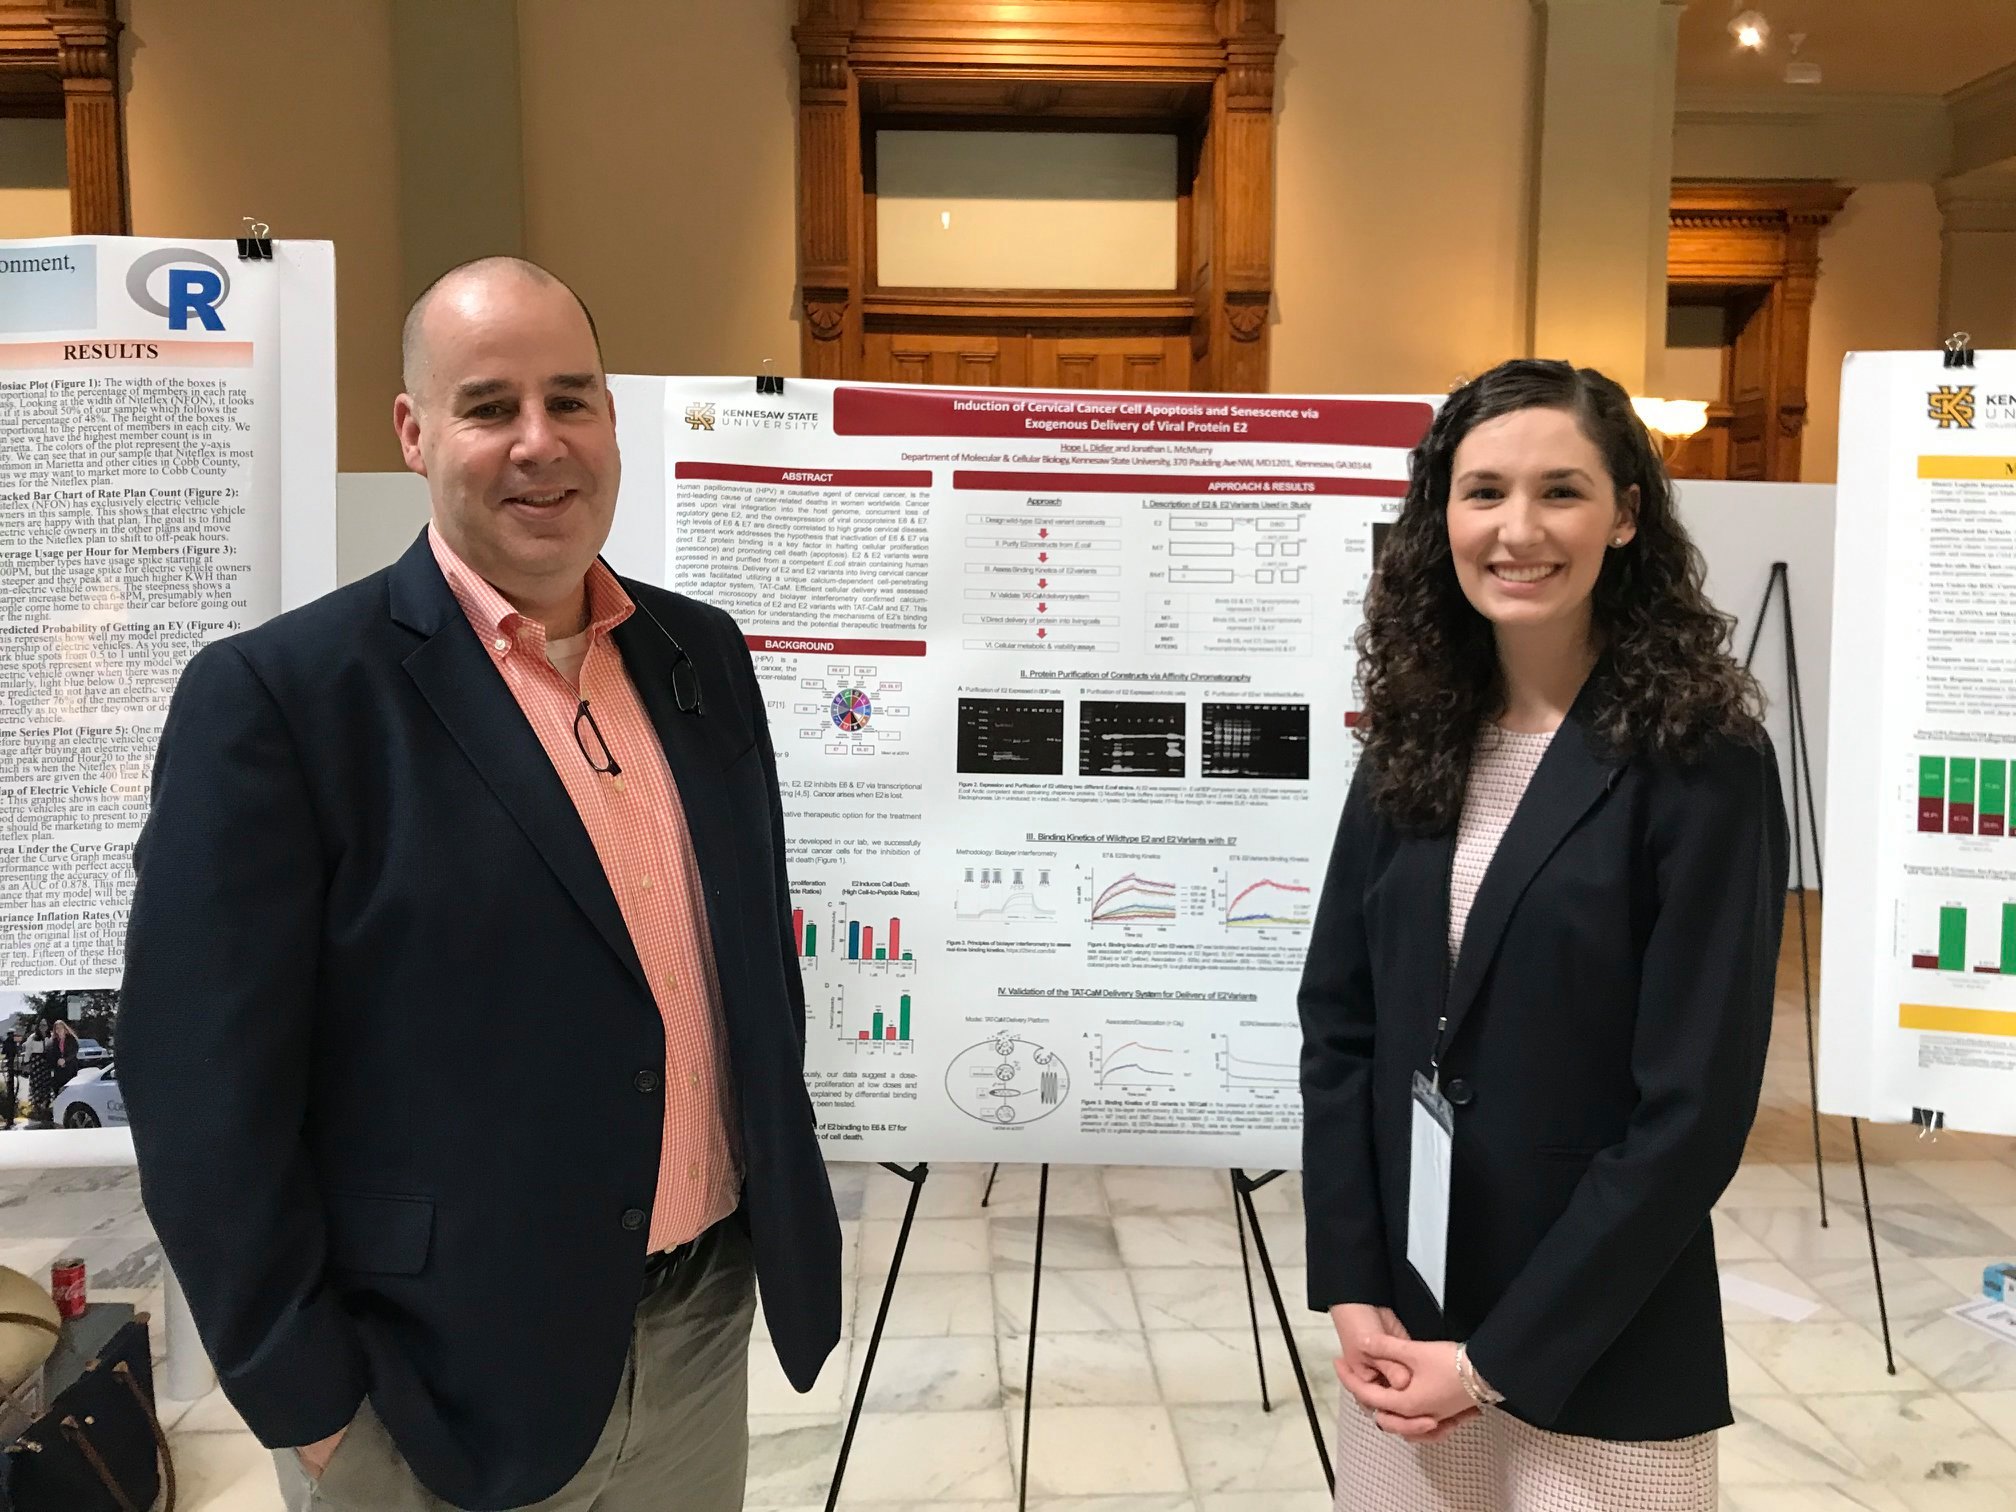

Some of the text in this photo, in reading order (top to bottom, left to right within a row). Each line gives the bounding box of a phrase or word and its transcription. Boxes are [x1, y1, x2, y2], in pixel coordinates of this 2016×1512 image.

[0, 254, 76, 273] onment,
[168, 269, 226, 331] R
[63, 343, 159, 361] RESULTS
[0, 377, 227, 391] osiac Plot (Figure 1): The width of the boxes is
[722, 409, 818, 421] KENNESAW STATE
[953, 400, 1320, 419] Induction of Cervical Cancer Cell Apoptosis and Senescence via
[722, 418, 818, 430] UNIVERSITY
[1024, 418, 1248, 434] Exogenous Delivery of Viral Protein E2
[1060, 443, 1081, 454] Hope
[1089, 444, 1114, 452] Didier
[1114, 444, 1130, 452] and
[1130, 444, 1165, 453] Jonathan
[1173, 445, 1213, 456] McMurry
[900, 453, 950, 464] Department
[951, 454, 960, 462] of
[961, 454, 1001, 463] Molecular
[1002, 455, 1010, 463] &
[1012, 455, 1041, 464] Cellular
[1071, 456, 1111, 465] Kennesaw
[1110, 457, 1130, 465] State
[781, 472, 834, 482] ABSTRACT
[1207, 482, 1316, 492] APPROACH & RESULTS
[33, 490, 52, 500] Bar
[53, 490, 83, 500] Chart
[85, 489, 96, 499] of
[98, 489, 121, 499] Rate
[123, 488, 147, 498] Plan
[149, 488, 181, 497] Count
[183, 487, 223, 499] (Figure
[224, 487, 239, 499] 2):
[1027, 498, 1062, 507] Approach
[34, 548, 64, 560] Usage
[66, 550, 83, 559] per
[85, 547, 112, 556] Hour
[114, 546, 130, 556] for
[132, 545, 180, 555] Members
[182, 545, 221, 557] (Figure
[222, 545, 237, 556] 3):
[42, 623, 98, 636] Probability
[100, 622, 112, 632] of
[112, 621, 151, 634] Getting
[152, 623, 165, 631] an
[167, 620, 184, 630] EV
[186, 620, 225, 632] (Figure
[226, 620, 241, 632] 4):
[765, 640, 834, 651] BACKGROUND
[1029, 670, 1056, 678] Protein
[1057, 670, 1100, 678] Purification
[1101, 671, 1109, 679] of
[1110, 671, 1149, 680] Constructs
[1150, 672, 1161, 680] via
[19, 727, 50, 737] Series
[53, 726, 73, 736] Plot
[75, 725, 113, 738] (Figure
[115, 725, 129, 737] 5):
[131, 724, 151, 734] One
[0, 783, 141, 798] ap of Electric Vehicle Count
[803, 811, 840, 820] therapeutic
[841, 811, 864, 820] option
[889, 812, 922, 820] treatment
[1037, 833, 1066, 843] Binding
[1066, 833, 1096, 842] Kinetics
[1096, 834, 1105, 842] of
[1106, 834, 1140, 845] Wildtype
[1141, 835, 1150, 843] E2
[1151, 835, 1165, 843] and
[1166, 835, 1176, 844] E2
[1177, 835, 1206, 844] Variants
[1208, 836, 1225, 844] with
[18, 844, 50, 854] Under
[52, 843, 68, 853] the
[69, 842, 101, 853] Curve
[37, 911, 79, 921] Inflation
[82, 910, 110, 920] Rates
[1008, 988, 1046, 996] Validation
[1046, 988, 1055, 996] of
[1055, 989, 1069, 997] the
[1102, 990, 1134, 1000] Delivery
[1135, 990, 1163, 1001] System
[1162, 991, 1174, 999] for
[1175, 991, 1206, 1002] Delivery
[1207, 992, 1216, 1000] of
[821, 1132, 828, 1140] of
[829, 1132, 842, 1140] cell
